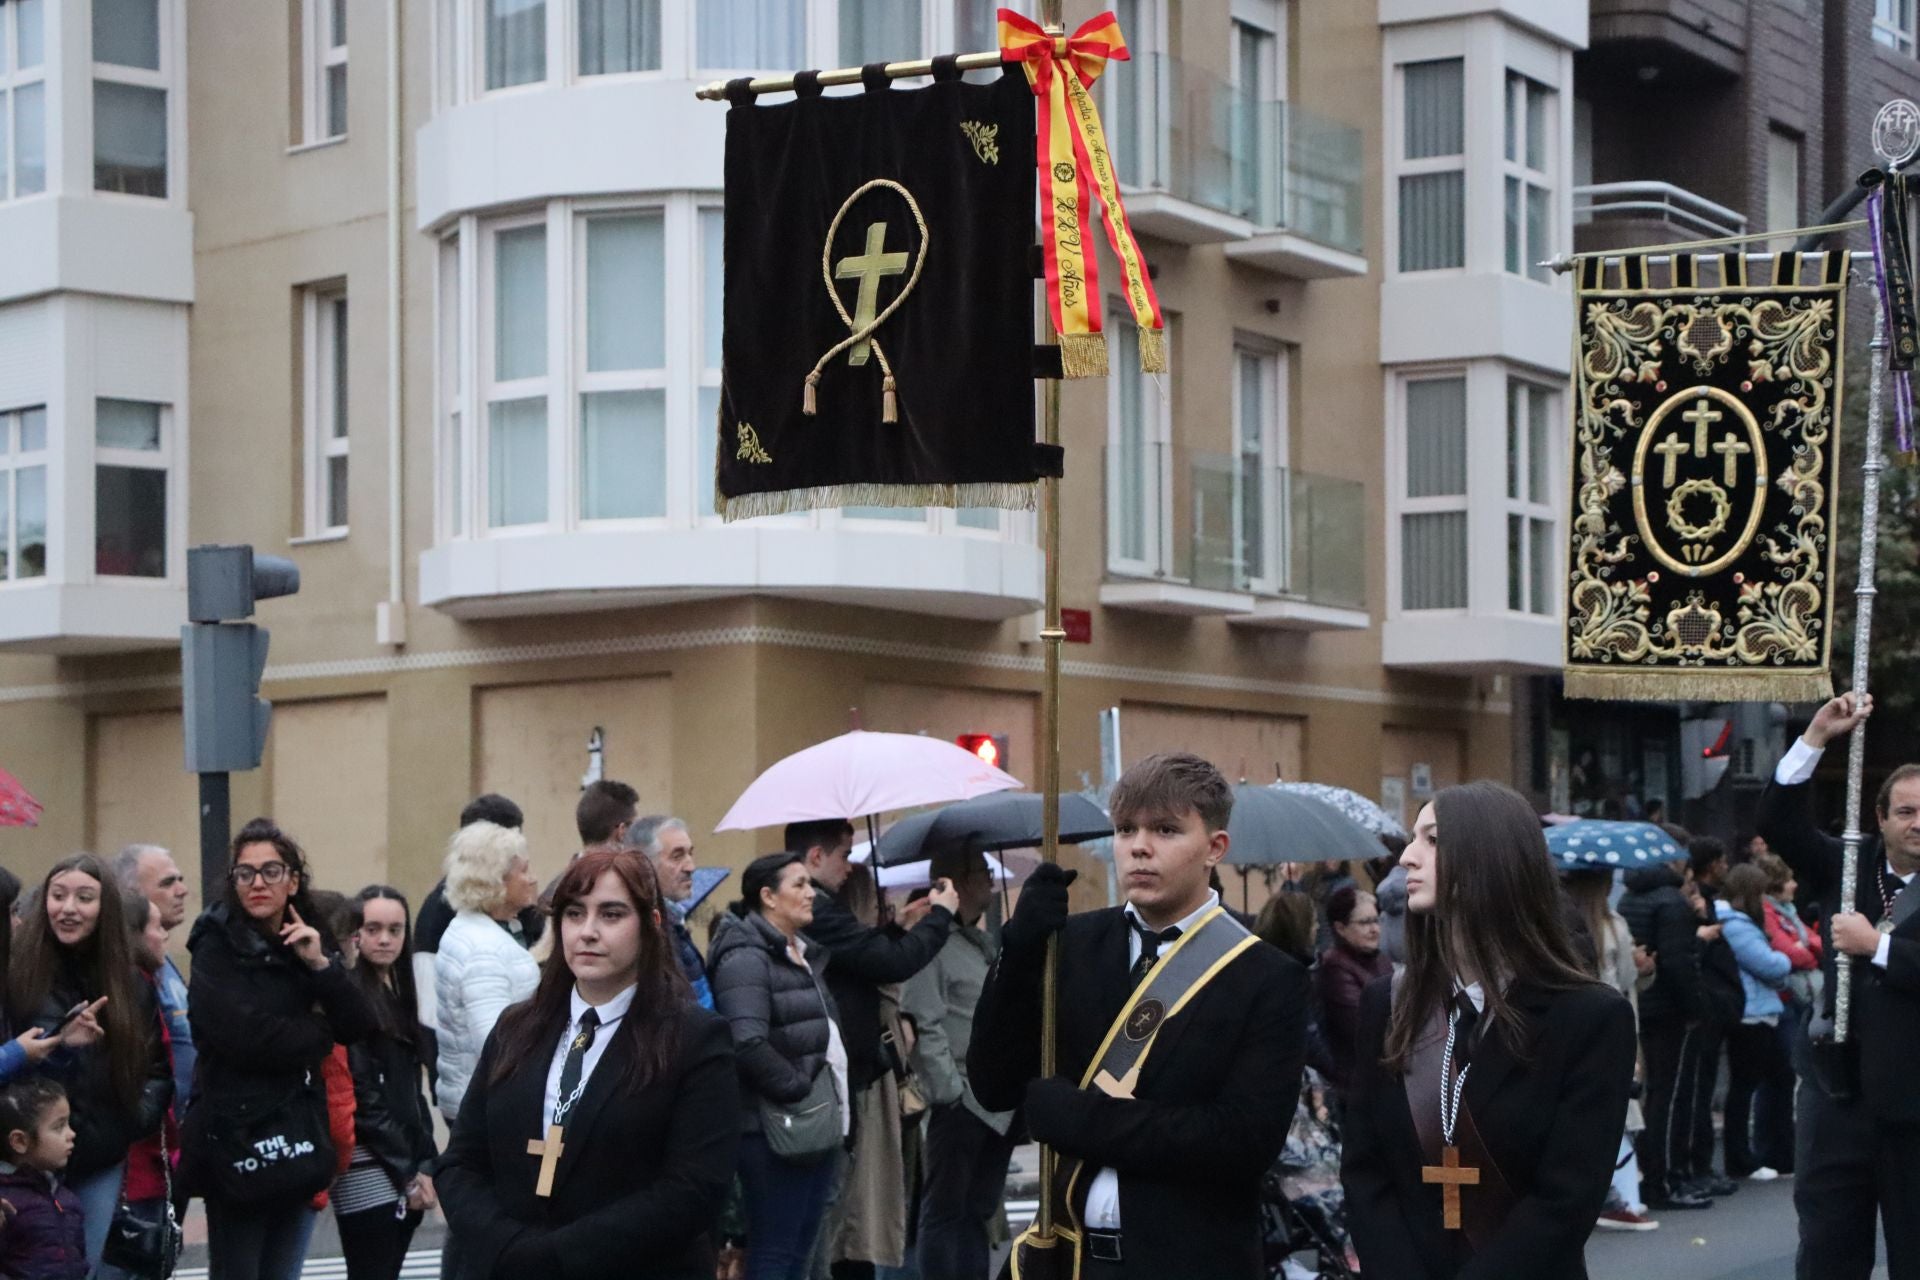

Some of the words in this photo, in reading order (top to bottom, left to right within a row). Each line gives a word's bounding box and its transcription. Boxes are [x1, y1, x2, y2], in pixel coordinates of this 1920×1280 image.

[1086, 123, 1097, 137] de
[1056, 196, 1082, 255] XXV
[1061, 259, 1084, 309] Años
[254, 1135, 288, 1154] THE
